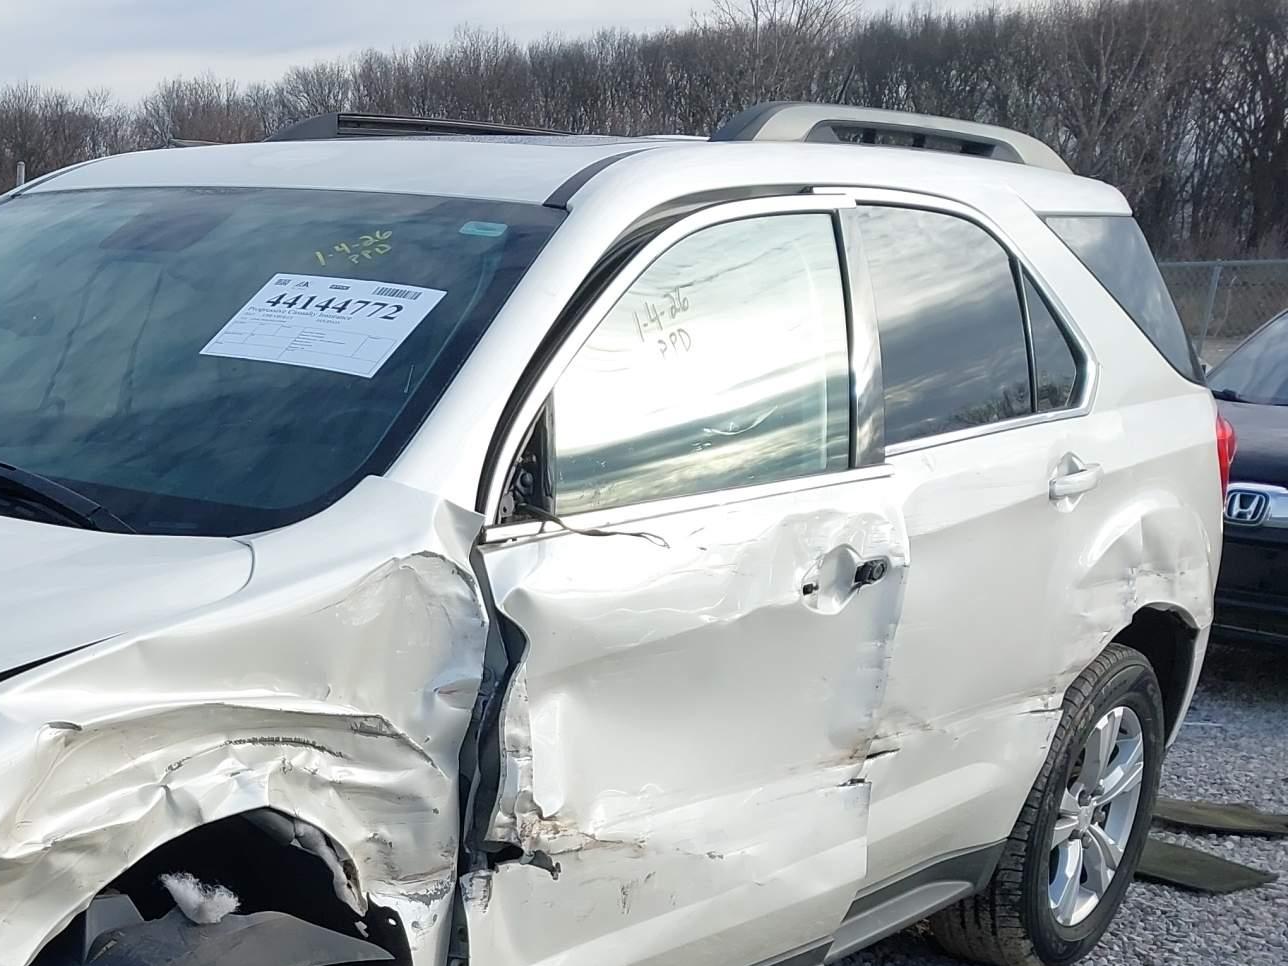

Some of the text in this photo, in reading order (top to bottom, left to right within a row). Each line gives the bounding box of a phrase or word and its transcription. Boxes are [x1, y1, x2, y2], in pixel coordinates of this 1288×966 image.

[315, 230, 392, 265] 1-4-26
[247, 306, 288, 316] Progressive
[287, 308, 316, 318] Casualty
[318, 311, 352, 321] Insurance
[266, 292, 404, 320] 44144772
